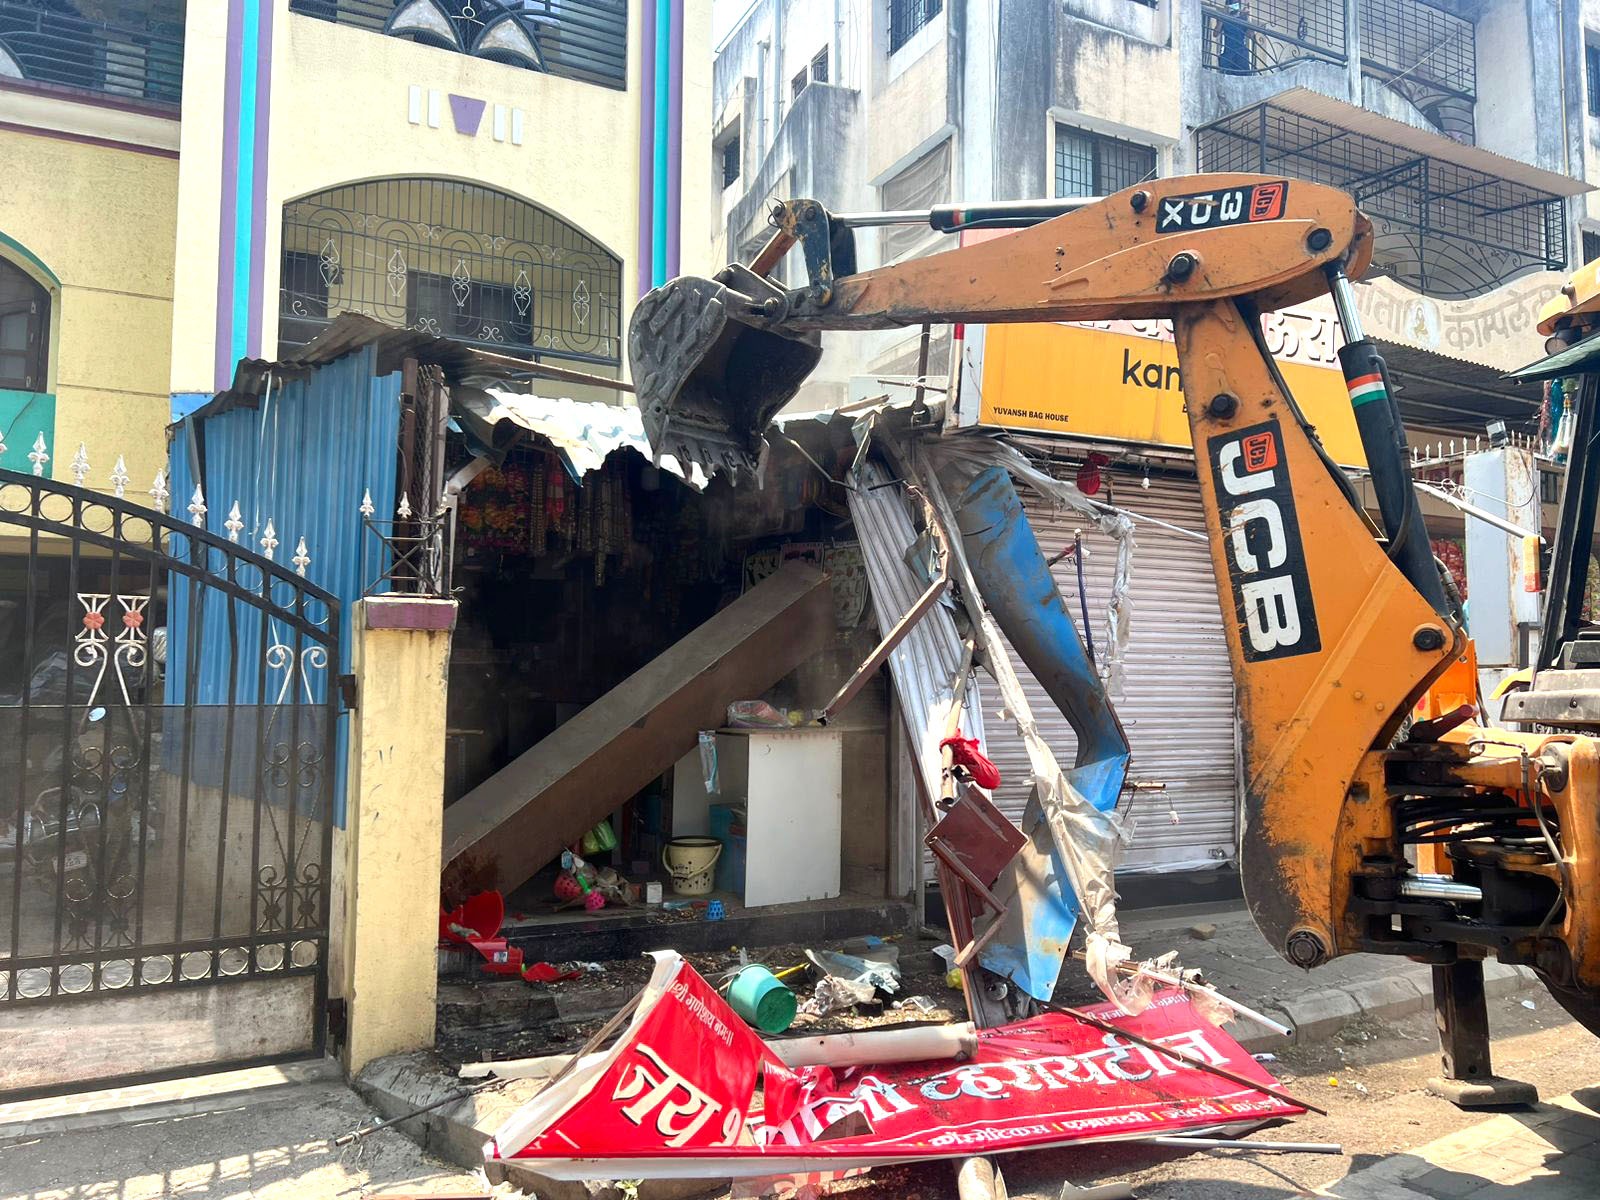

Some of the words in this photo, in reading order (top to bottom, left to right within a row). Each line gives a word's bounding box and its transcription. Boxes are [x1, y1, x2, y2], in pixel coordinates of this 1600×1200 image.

[1254, 187, 1276, 216] JCB
[993, 406, 1028, 418] YUVANSH
[1028, 410, 1044, 420] BAG
[1045, 412, 1069, 423] HOUSE
[1249, 438, 1267, 466] JCB
[1219, 439, 1301, 652] JCB
[612, 1042, 723, 1148] जय
